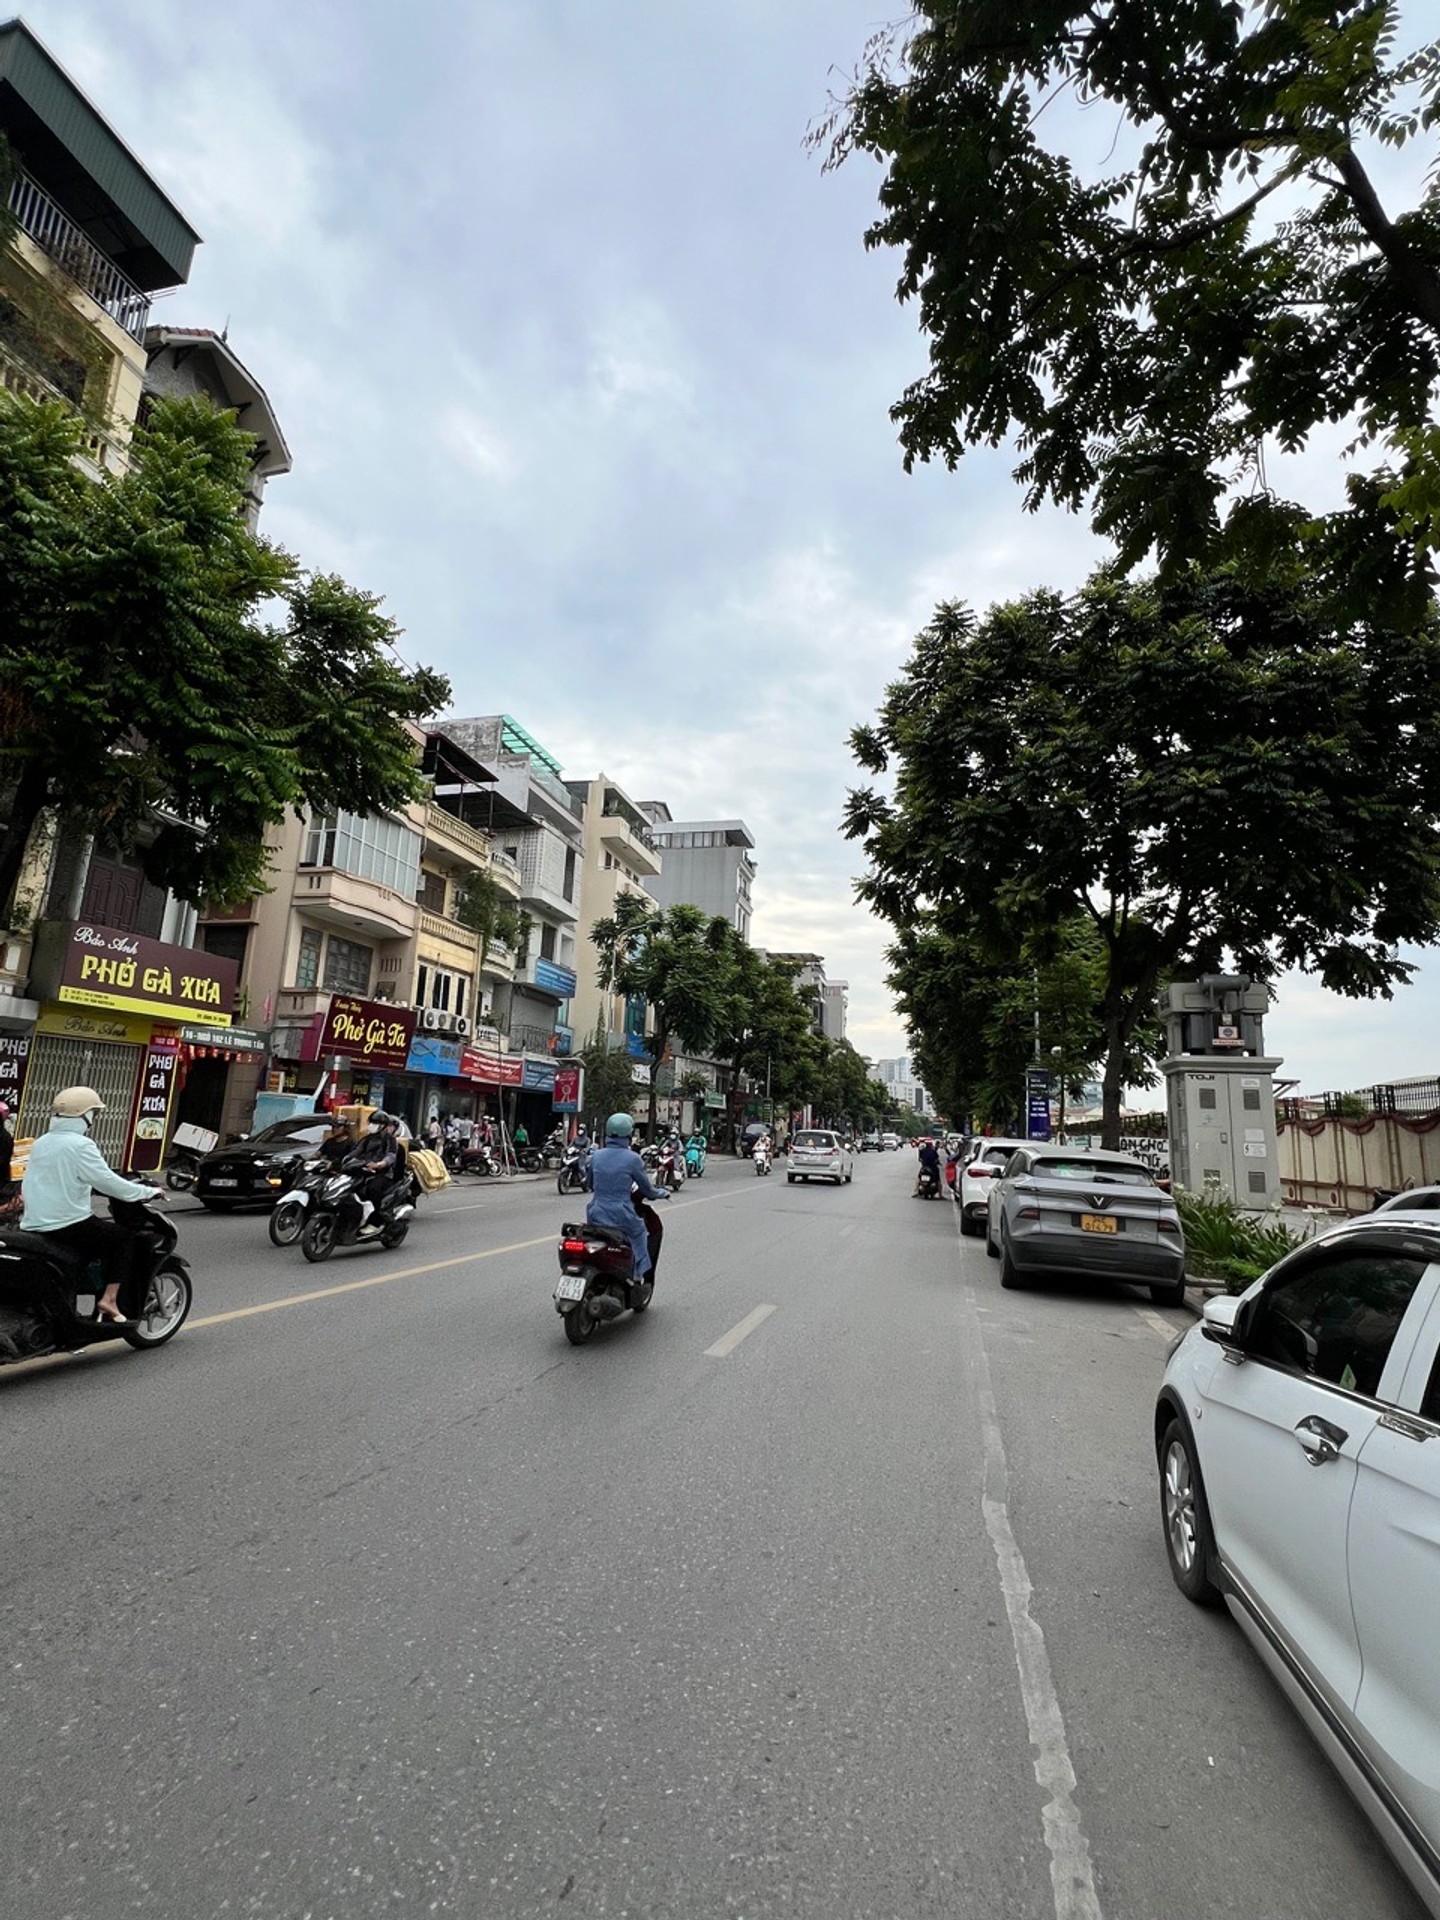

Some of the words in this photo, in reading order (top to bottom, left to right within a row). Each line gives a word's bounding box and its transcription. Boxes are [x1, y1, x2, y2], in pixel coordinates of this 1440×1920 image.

[108, 937, 139, 955] Anh
[80, 954, 137, 988] PHỞ
[142, 966, 173, 996] GÀ
[180, 976, 221, 1005] XƯA
[332, 1014, 366, 1041] Phở
[363, 1019, 386, 1054] Gà
[387, 1023, 406, 1048] Ta
[150, 1072, 165, 1089] GÀ
[142, 1096, 166, 1111] XƯA
